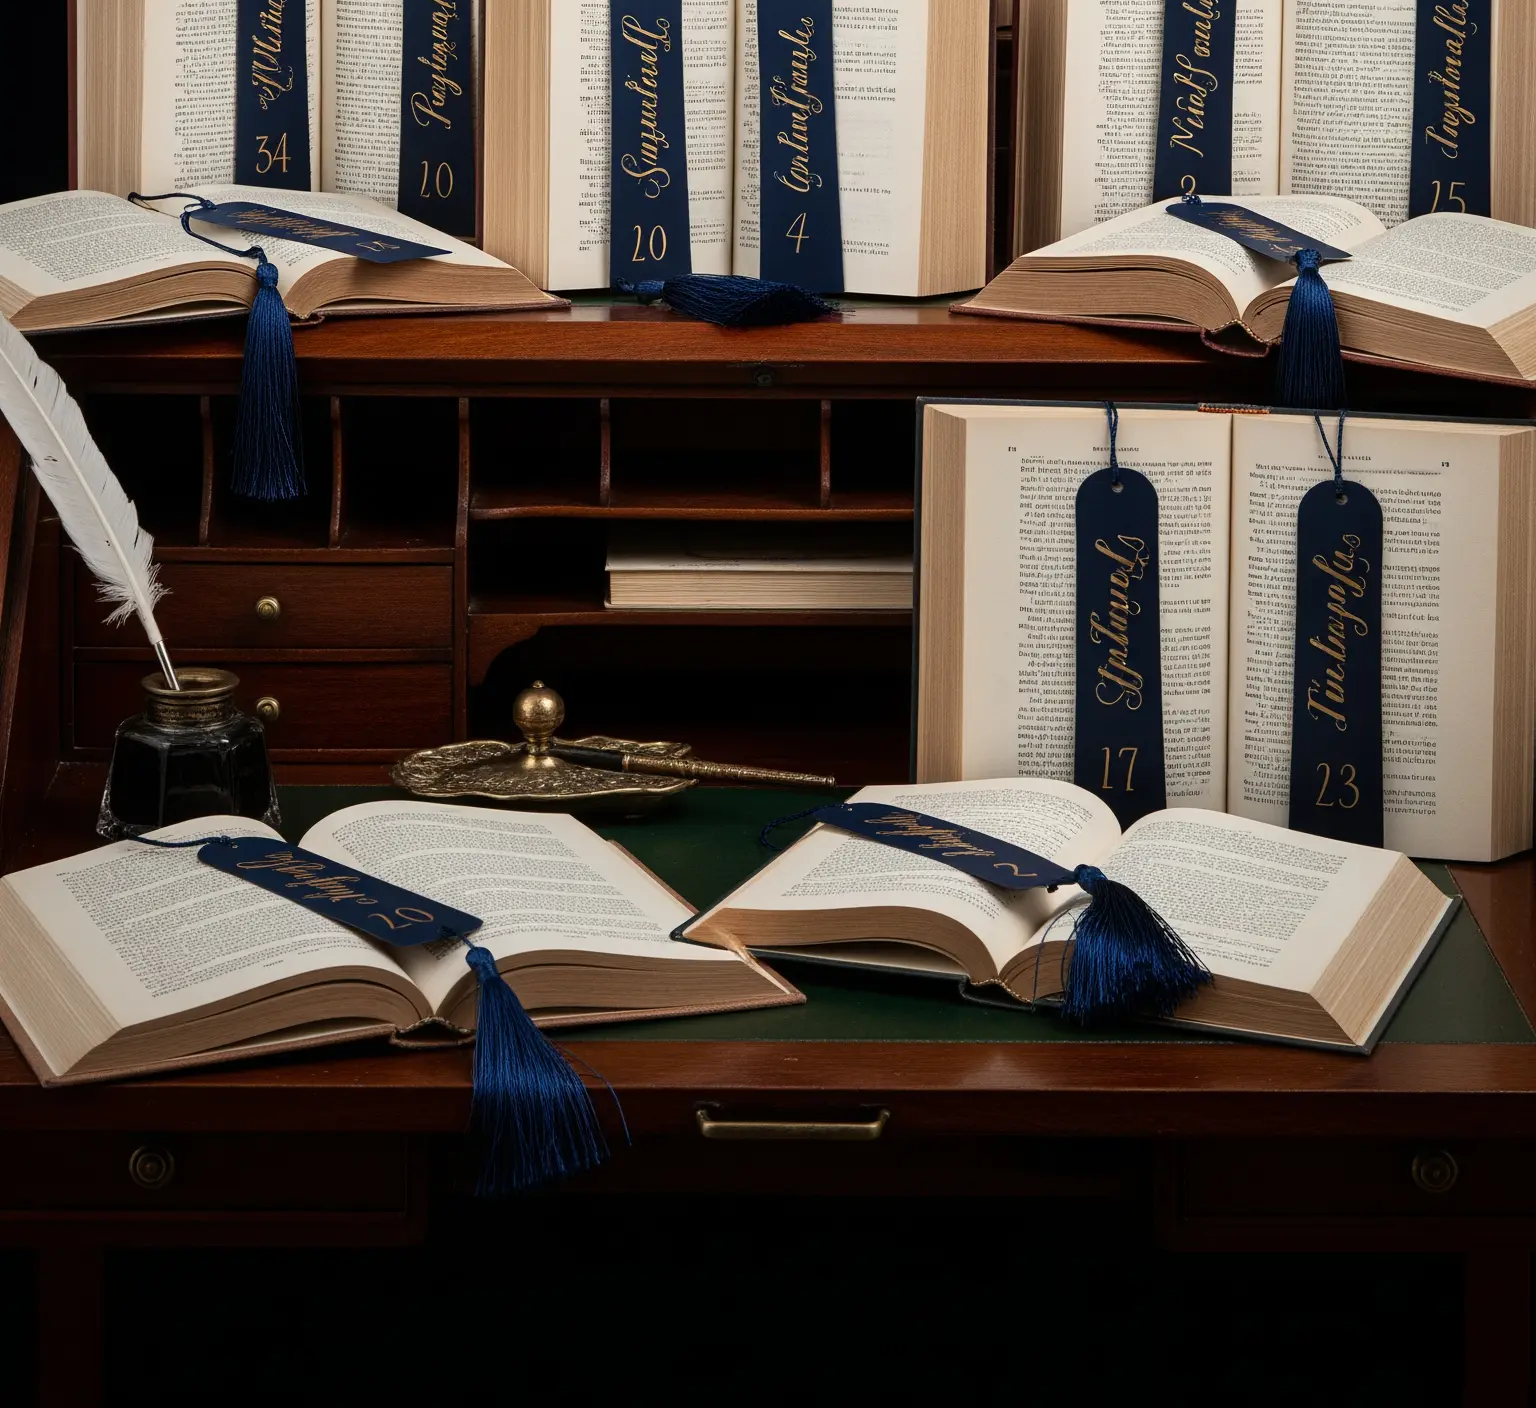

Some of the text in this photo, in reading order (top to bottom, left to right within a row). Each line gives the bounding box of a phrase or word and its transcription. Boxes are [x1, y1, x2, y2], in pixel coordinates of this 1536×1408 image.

[254, 132, 291, 173] 34
[785, 212, 810, 254] 4
[1101, 746, 1139, 792] 17
[1317, 762, 1359, 808] 23
